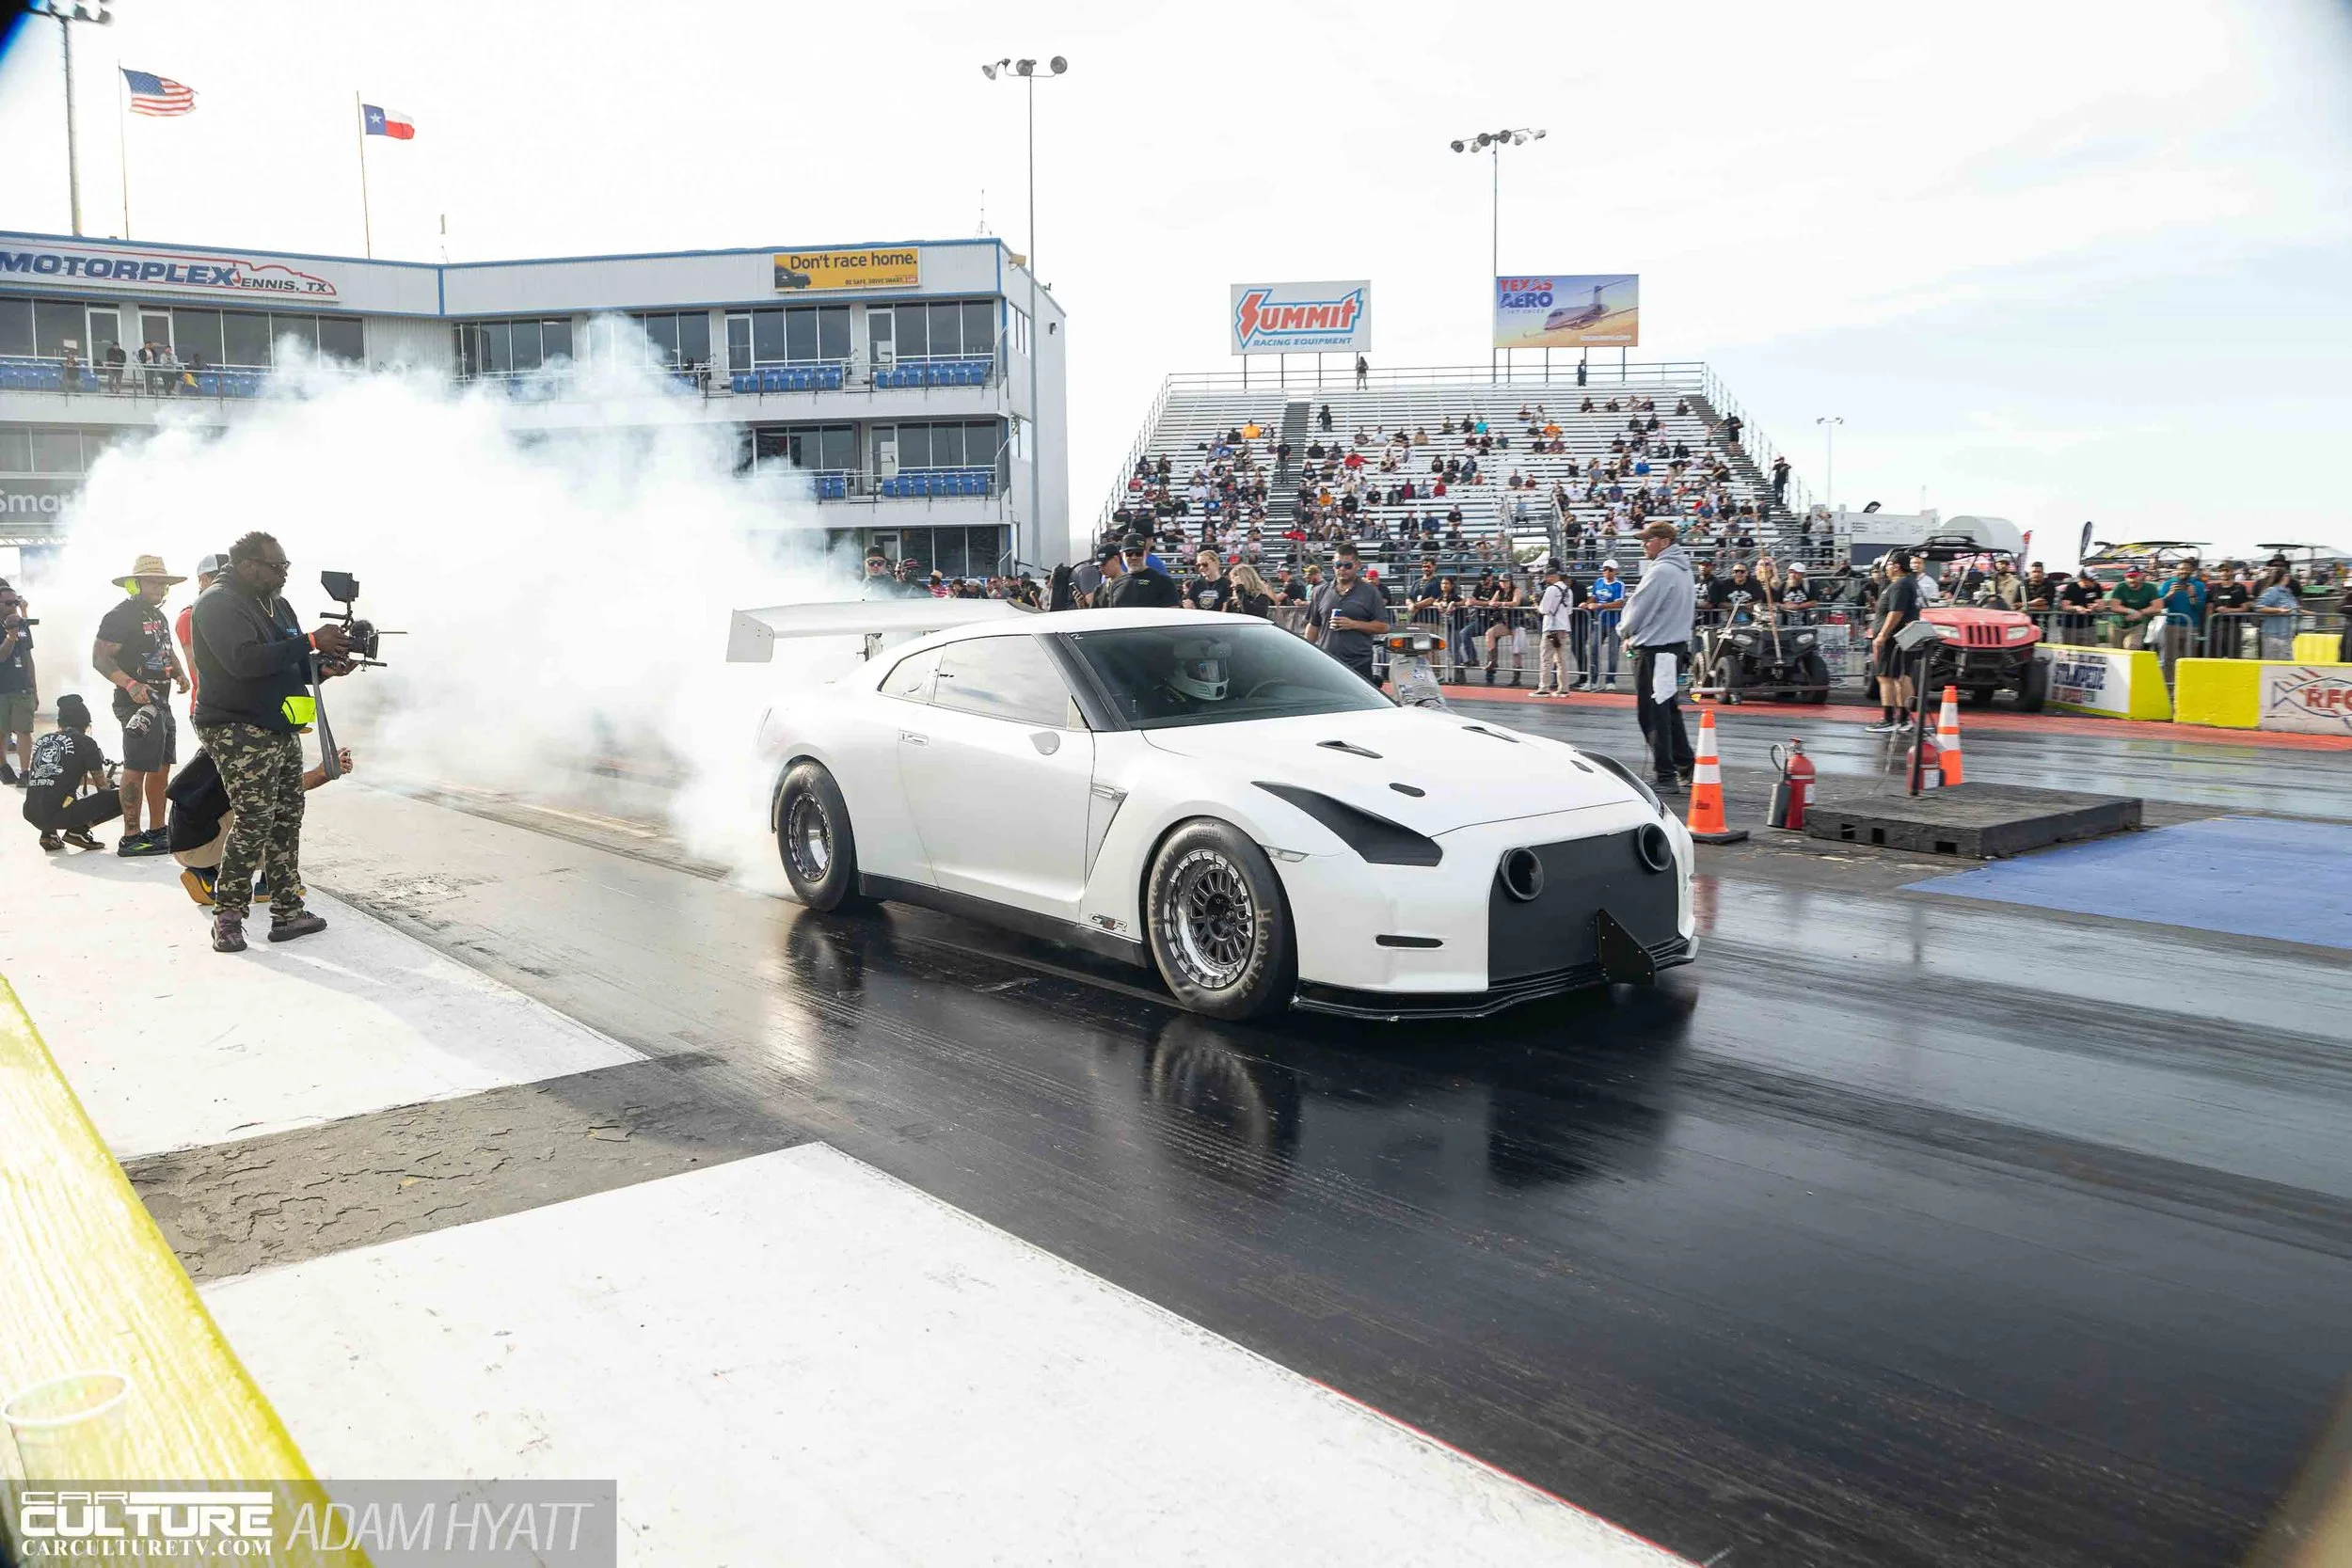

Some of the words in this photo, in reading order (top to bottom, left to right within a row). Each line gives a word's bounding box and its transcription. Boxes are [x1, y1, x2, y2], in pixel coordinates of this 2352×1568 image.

[0, 251, 237, 286] MOTORPLEX
[790, 255, 830, 270] Don't
[834, 256, 867, 268] race
[871, 252, 917, 266] home.
[241, 277, 299, 293] ENNIS,
[306, 281, 327, 293] TX
[1500, 278, 1552, 293] TEXAS
[1499, 292, 1553, 309] AERO
[1253, 339, 1291, 347] RACING
[1294, 338, 1353, 346] EQUIPMENT
